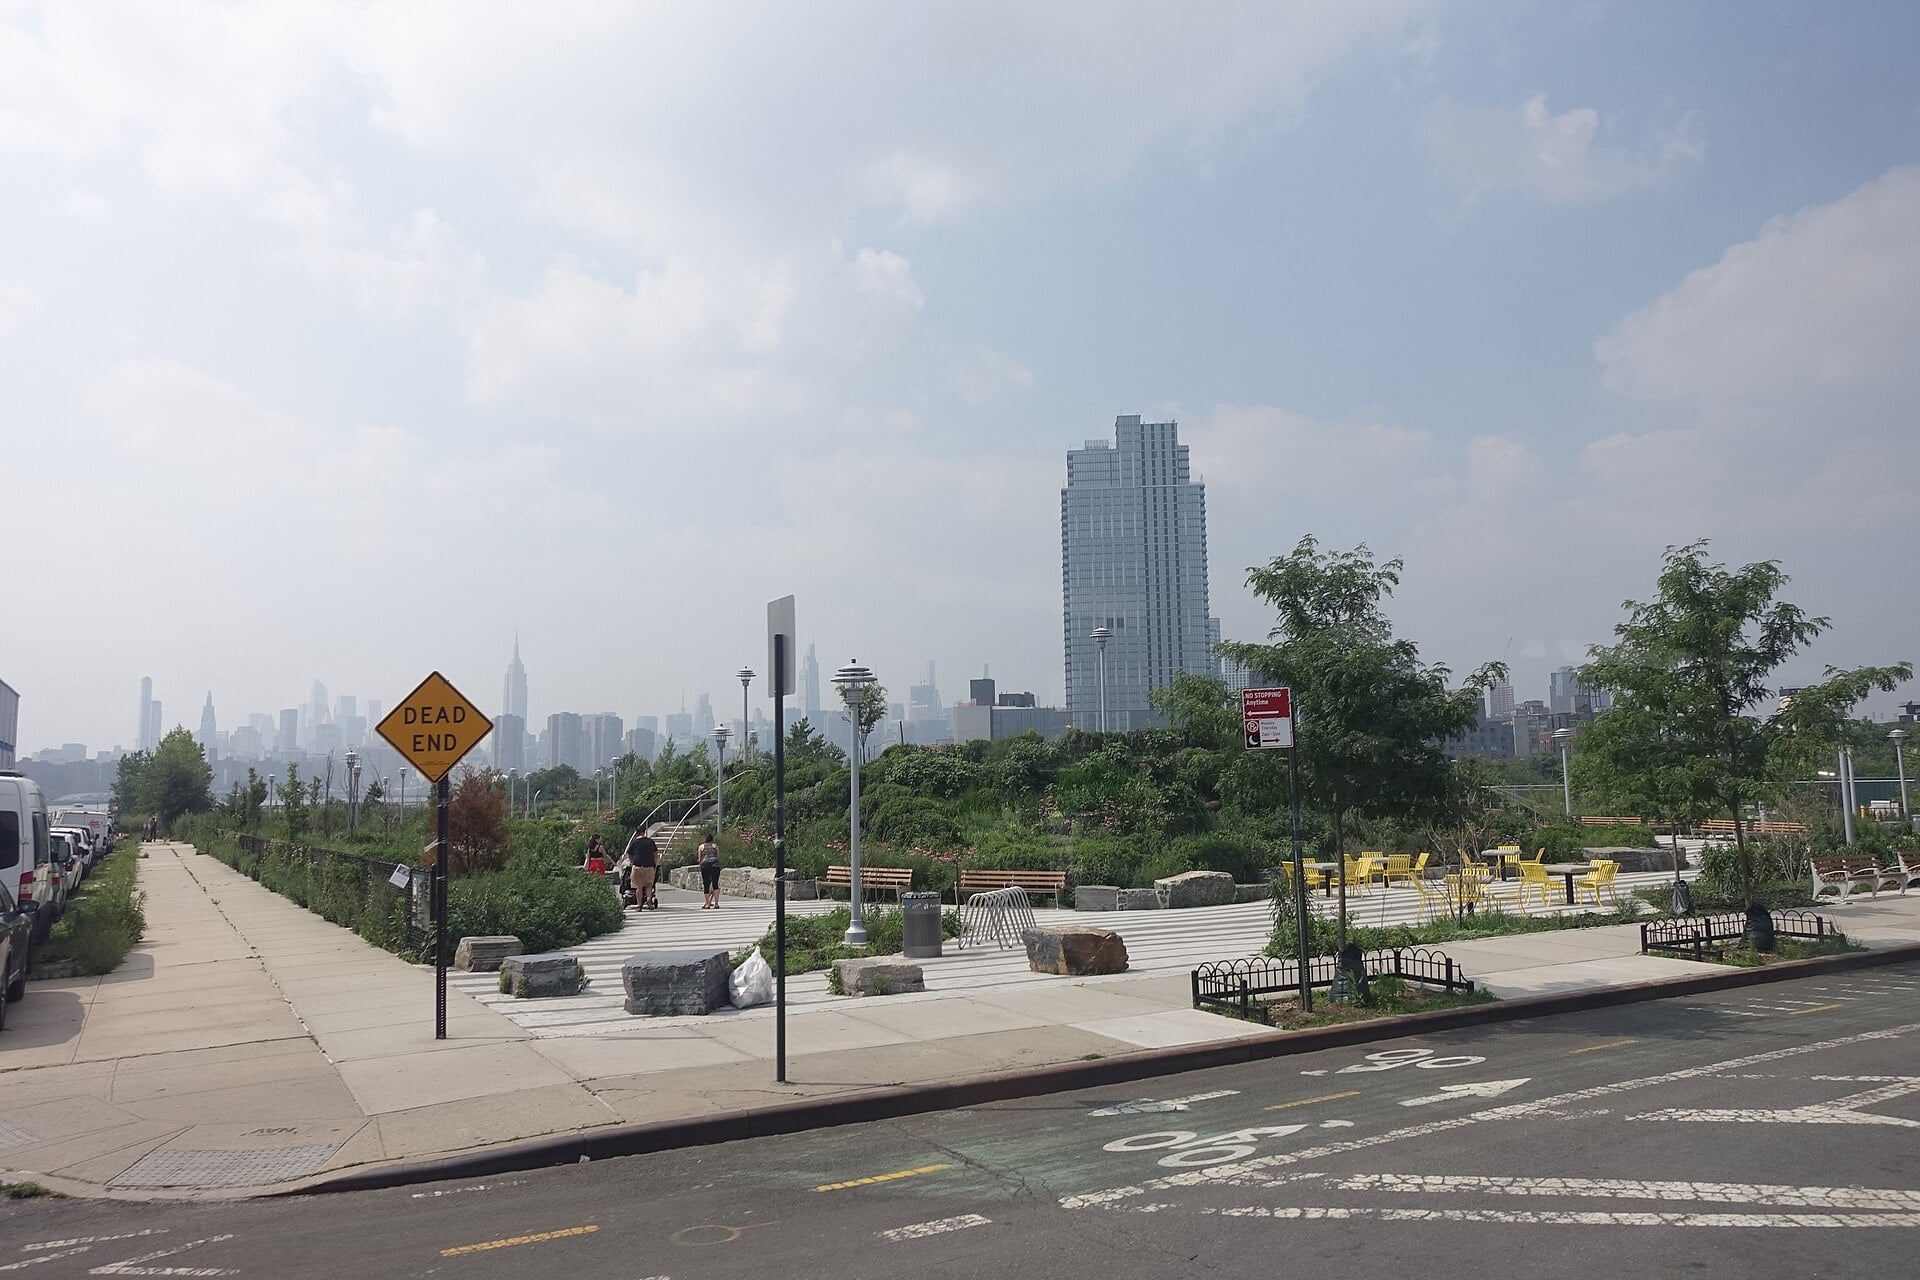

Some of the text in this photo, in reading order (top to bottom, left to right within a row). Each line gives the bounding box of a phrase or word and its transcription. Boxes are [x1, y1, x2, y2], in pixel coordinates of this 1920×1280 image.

[1254, 691, 1281, 699] STOPPING
[1246, 699, 1269, 707] Anytime
[404, 706, 466, 725] DEAD
[413, 734, 457, 752] END
